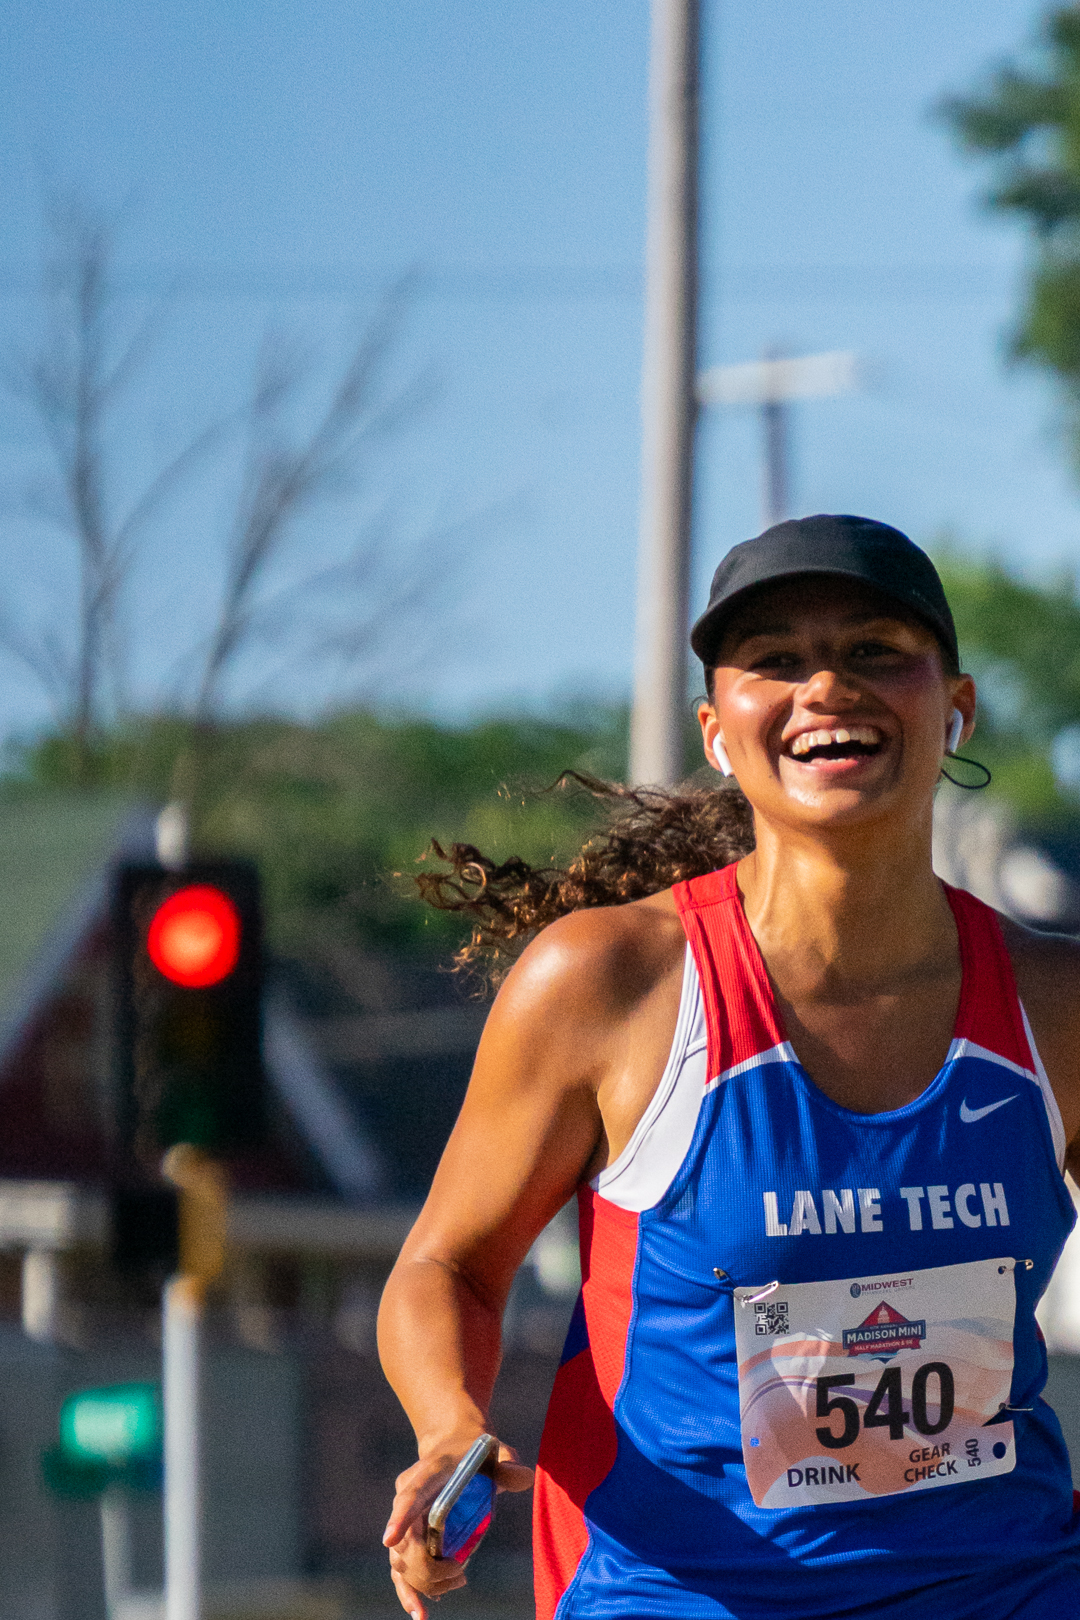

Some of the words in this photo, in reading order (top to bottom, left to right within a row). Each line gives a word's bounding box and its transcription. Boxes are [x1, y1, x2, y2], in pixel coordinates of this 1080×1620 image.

[763, 1188, 884, 1237] LANE
[900, 1182, 1010, 1231] TECH
[861, 1278, 914, 1291] MIDWEST
[847, 1329, 896, 1344] MADISON
[898, 1325, 921, 1336] MINI
[816, 1362, 955, 1449] 540
[909, 1443, 951, 1463] GEAR
[965, 1438, 982, 1467] 540
[787, 1463, 861, 1488] DRINK
[904, 1460, 958, 1483] CHECK
